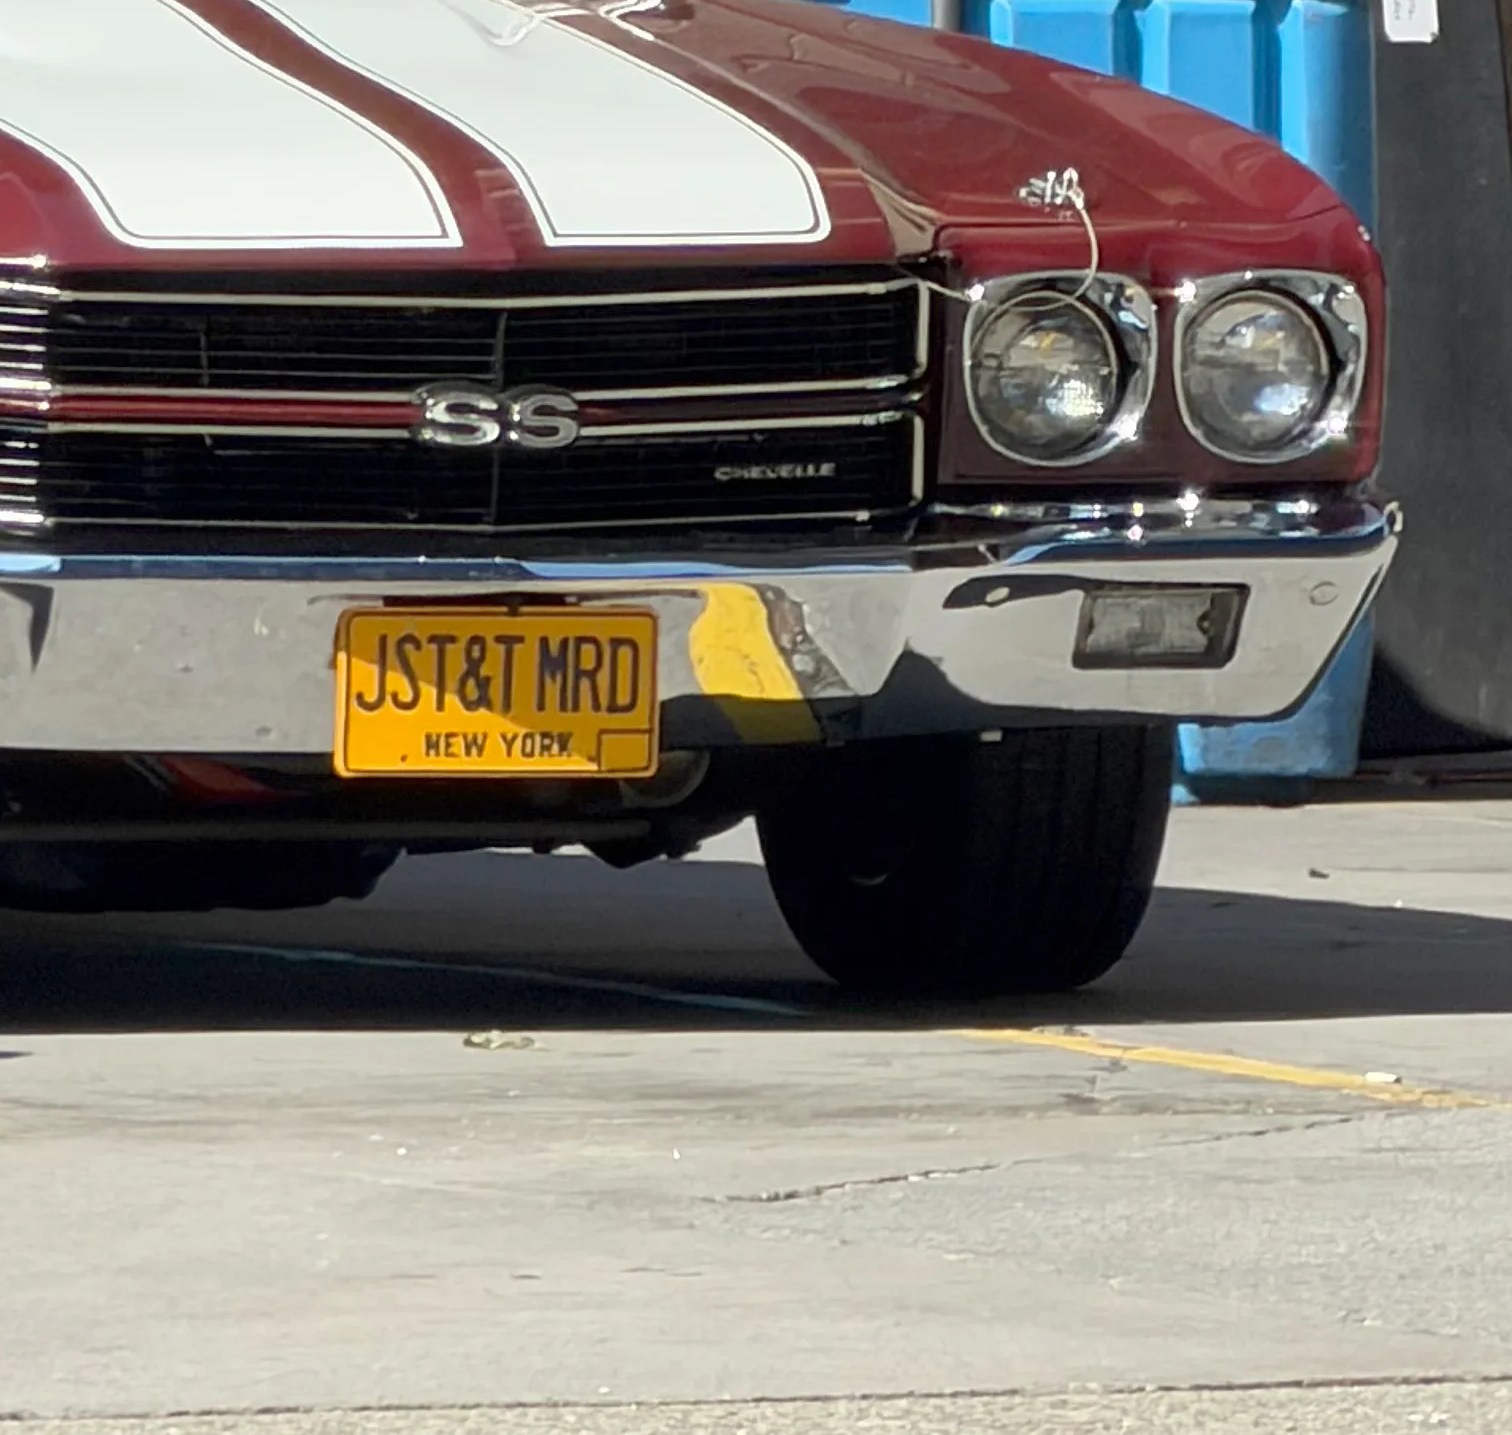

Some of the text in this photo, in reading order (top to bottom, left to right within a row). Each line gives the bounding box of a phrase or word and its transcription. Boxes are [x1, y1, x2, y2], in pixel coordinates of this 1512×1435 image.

[414, 381, 580, 448] SS
[713, 462, 836, 481] CHEVELLE
[355, 632, 639, 715] JST&T MRD
[424, 731, 574, 758] NEW YORK
